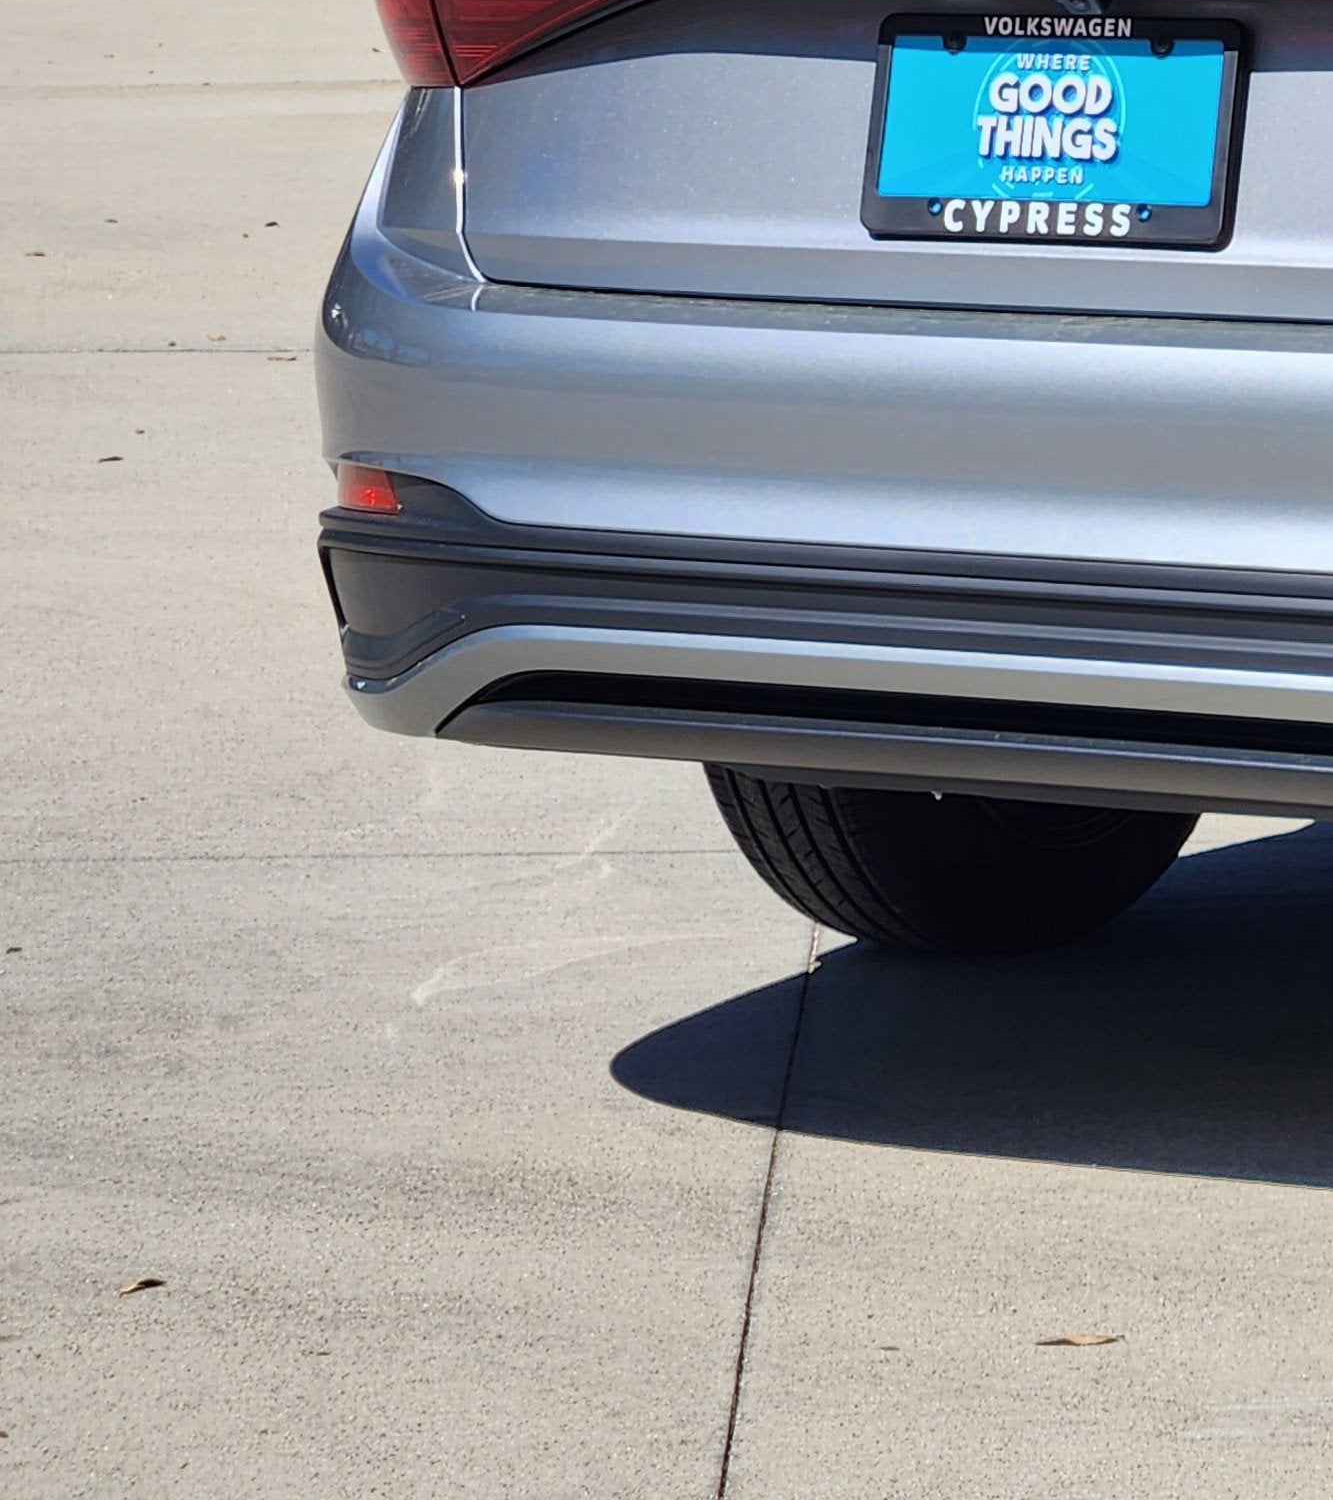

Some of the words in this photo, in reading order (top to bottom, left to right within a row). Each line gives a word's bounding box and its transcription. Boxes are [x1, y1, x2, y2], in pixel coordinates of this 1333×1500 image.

[984, 16, 1133, 37] VOLKSWAGEN
[1016, 53, 1092, 72] WHERE
[988, 72, 1114, 116] GOOD
[976, 114, 1121, 162] THINGS
[1000, 165, 1085, 185] HAPPEN
[943, 198, 1133, 238] CYPRESS
